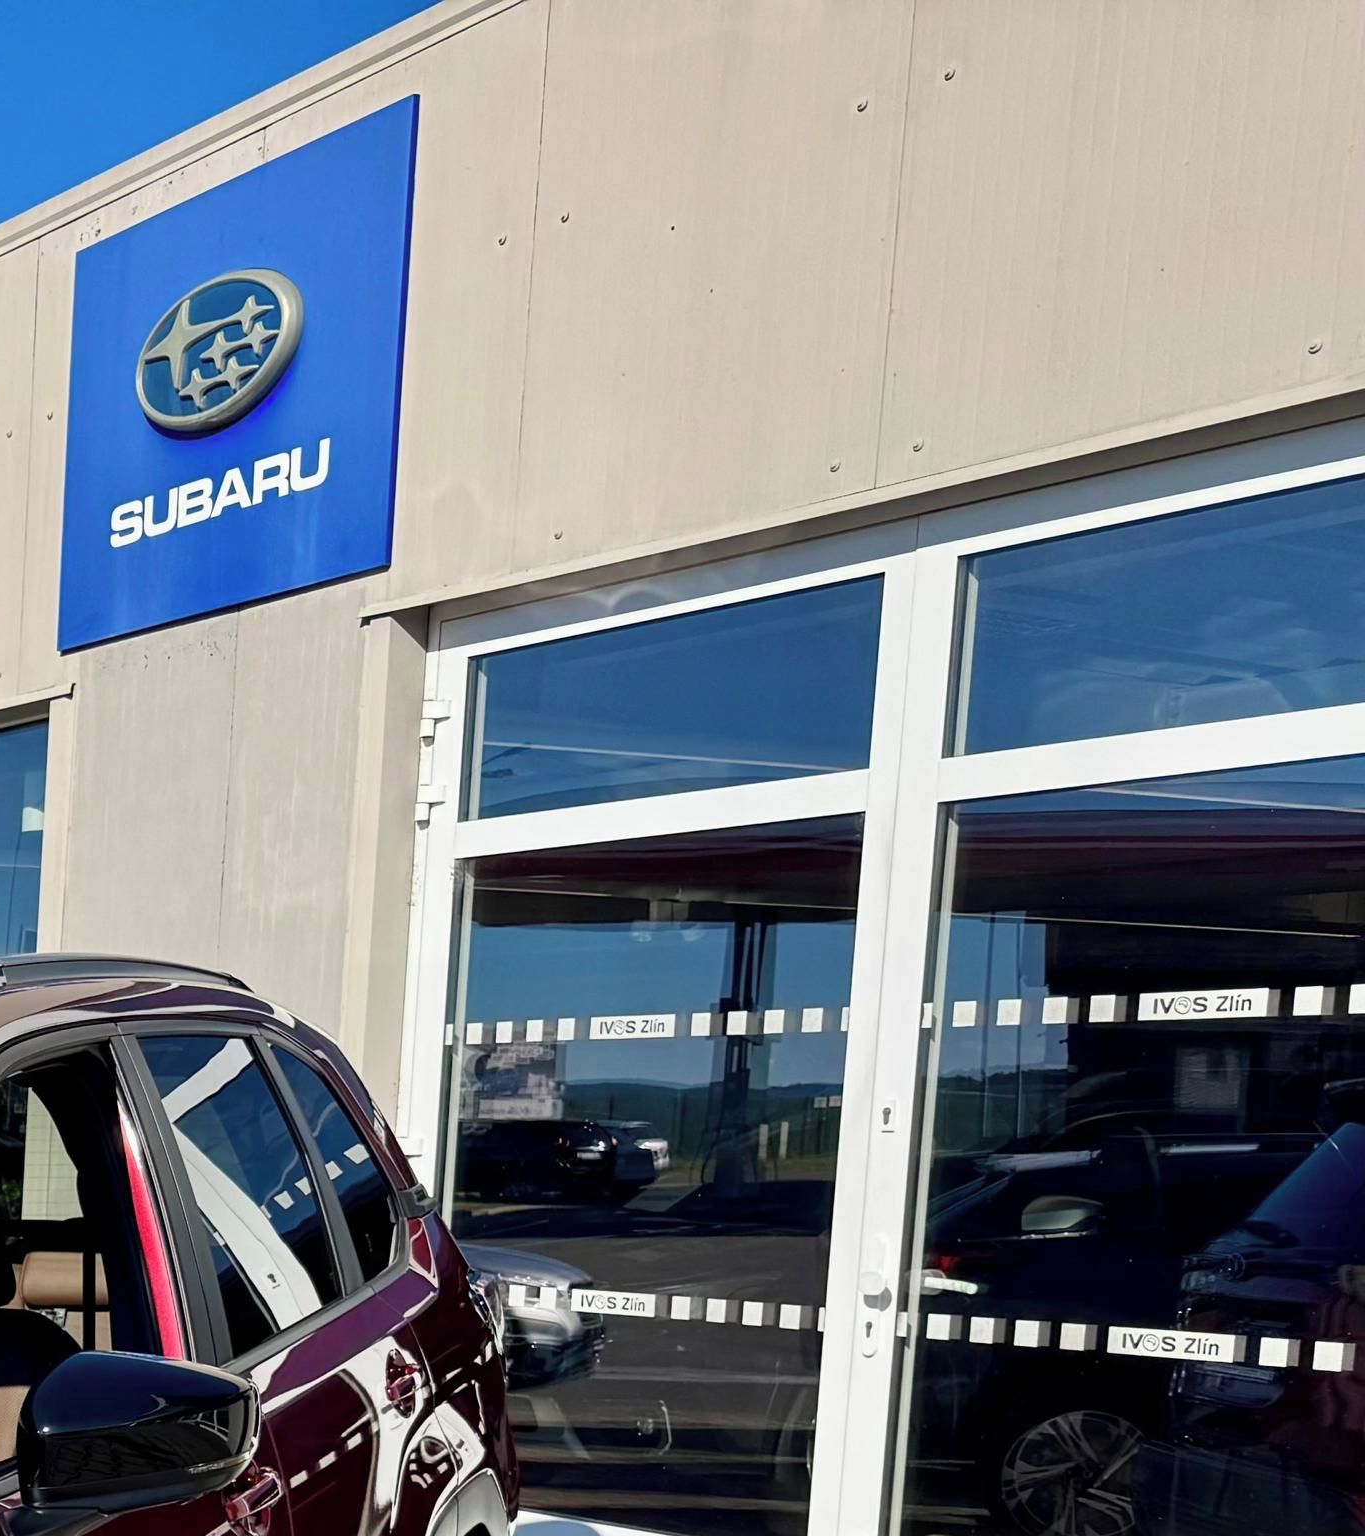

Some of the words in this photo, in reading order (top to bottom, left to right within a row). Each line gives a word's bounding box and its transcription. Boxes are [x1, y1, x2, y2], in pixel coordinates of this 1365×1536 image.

[110, 438, 330, 548] SUBARU
[1215, 993, 1253, 1013] Zlín
[640, 1018, 666, 1034] Zlín
[621, 1296, 646, 1312] Zlín
[1183, 1337, 1220, 1356] Zlín
